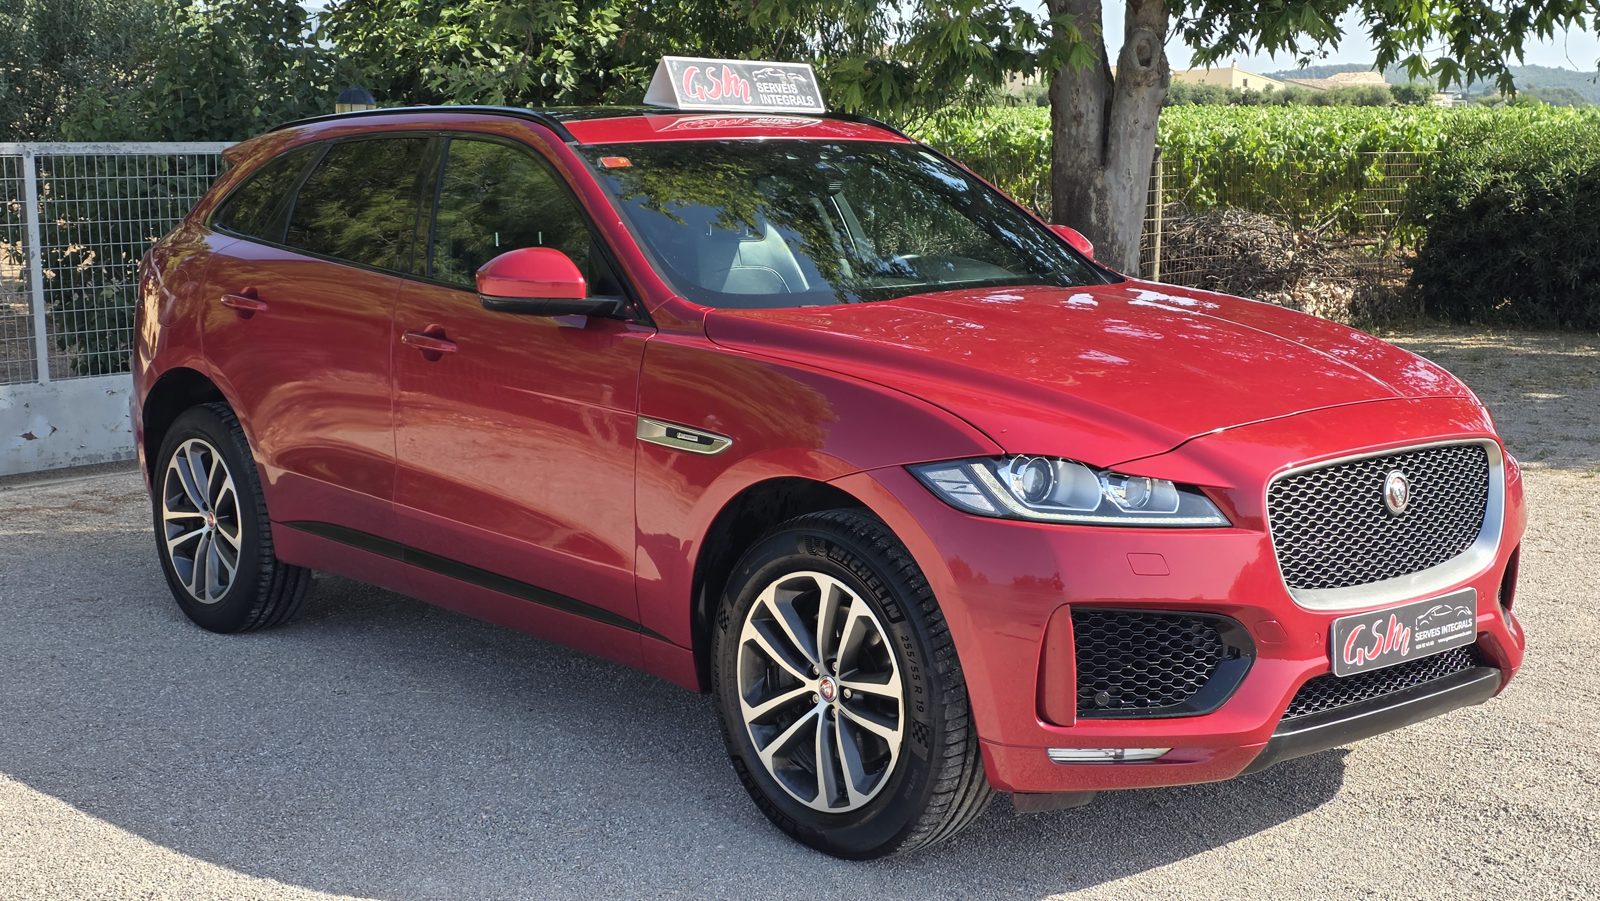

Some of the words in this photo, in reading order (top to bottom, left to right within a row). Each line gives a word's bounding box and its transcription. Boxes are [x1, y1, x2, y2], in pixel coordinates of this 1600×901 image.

[756, 82, 799, 95] SERVEIS
[759, 94, 815, 107] INTEGRALS
[829, 544, 901, 619] MICHELIN
[1415, 626, 1441, 641] SERVEIS
[1441, 618, 1473, 634] INTEGRALS
[900, 634, 921, 681] 255/55
[913, 685, 923, 695] R
[915, 700, 925, 714] 19
